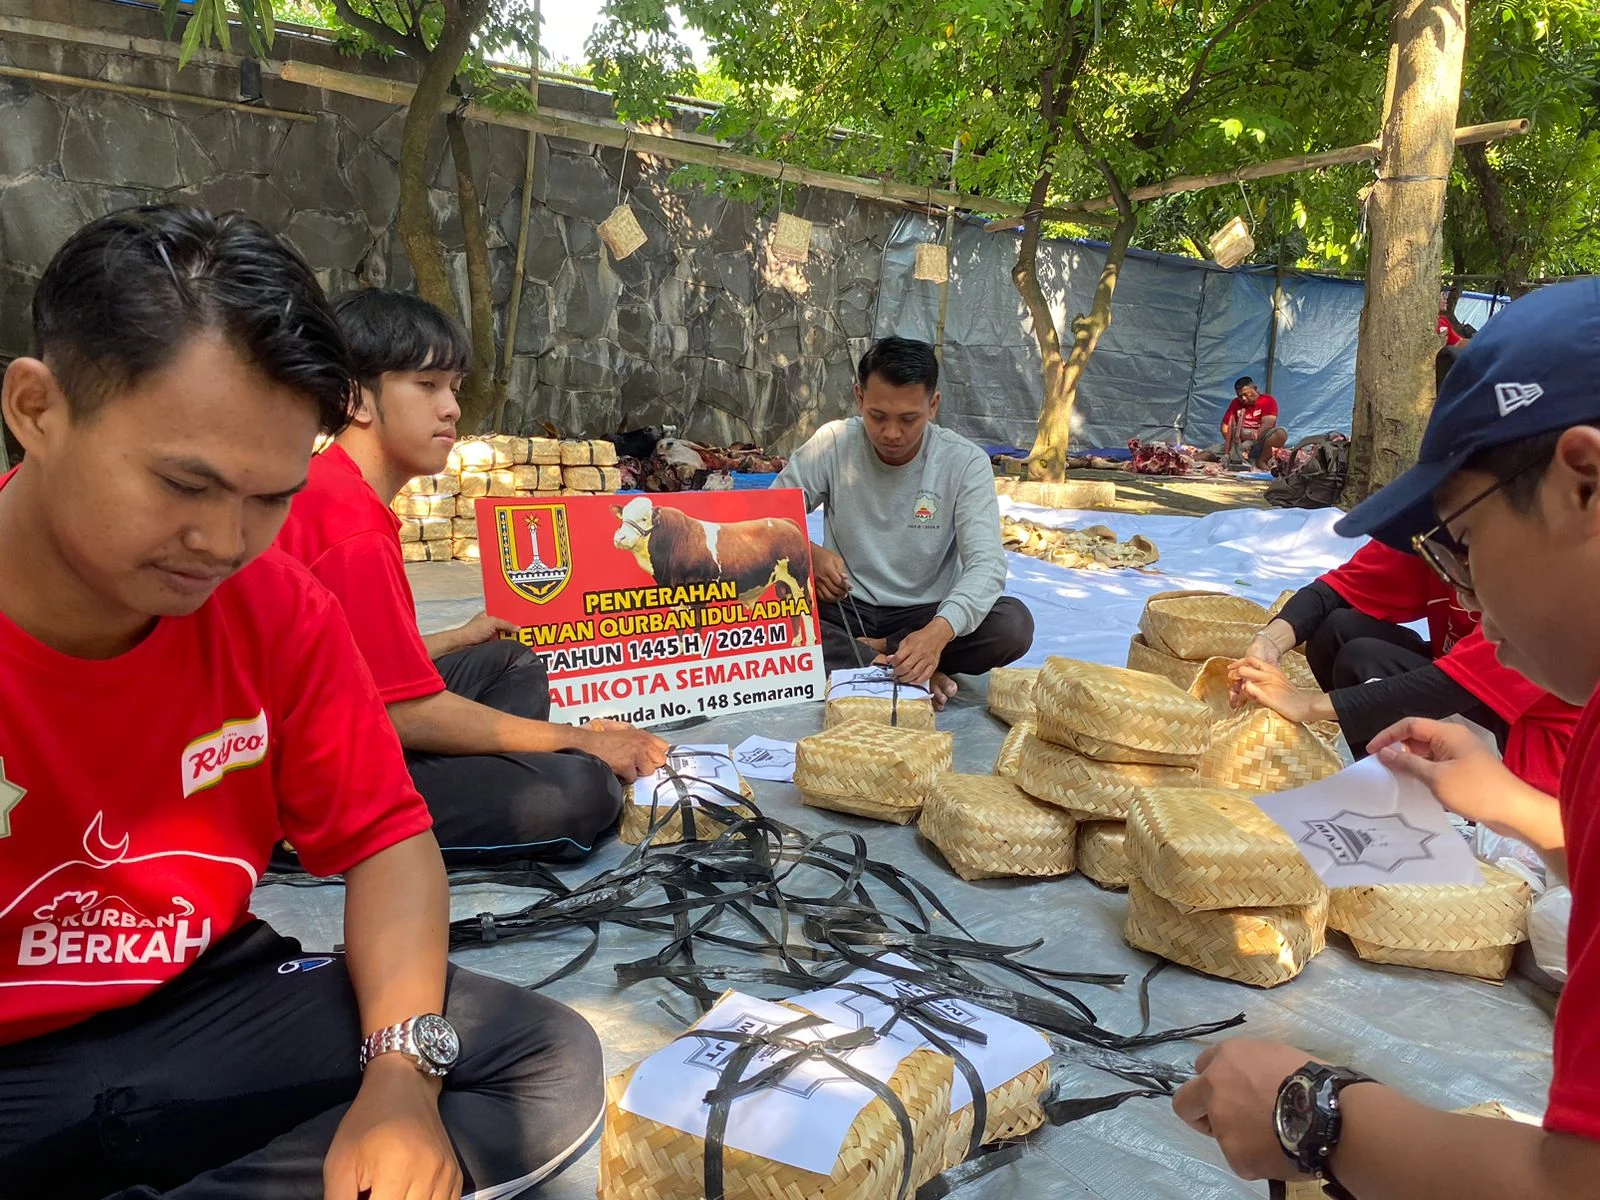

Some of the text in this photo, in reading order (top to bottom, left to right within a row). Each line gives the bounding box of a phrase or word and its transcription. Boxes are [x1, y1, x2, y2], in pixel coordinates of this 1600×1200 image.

[585, 581, 737, 613] PENYERAHAN
[599, 609, 696, 637] QURBAN
[701, 604, 748, 626] IDUL
[751, 598, 811, 620] ADHA
[537, 625, 786, 673] TAHUN 1445 H / 2024 M
[548, 652, 814, 708] ALIKOTA SEMARANG
[579, 684, 814, 726] Pmuda No. 148 Semarang
[1314, 824, 1349, 860] MAJT
[61, 908, 175, 928] KURBAN
[17, 917, 211, 966] BERKAH
[705, 1021, 756, 1062] MJT
